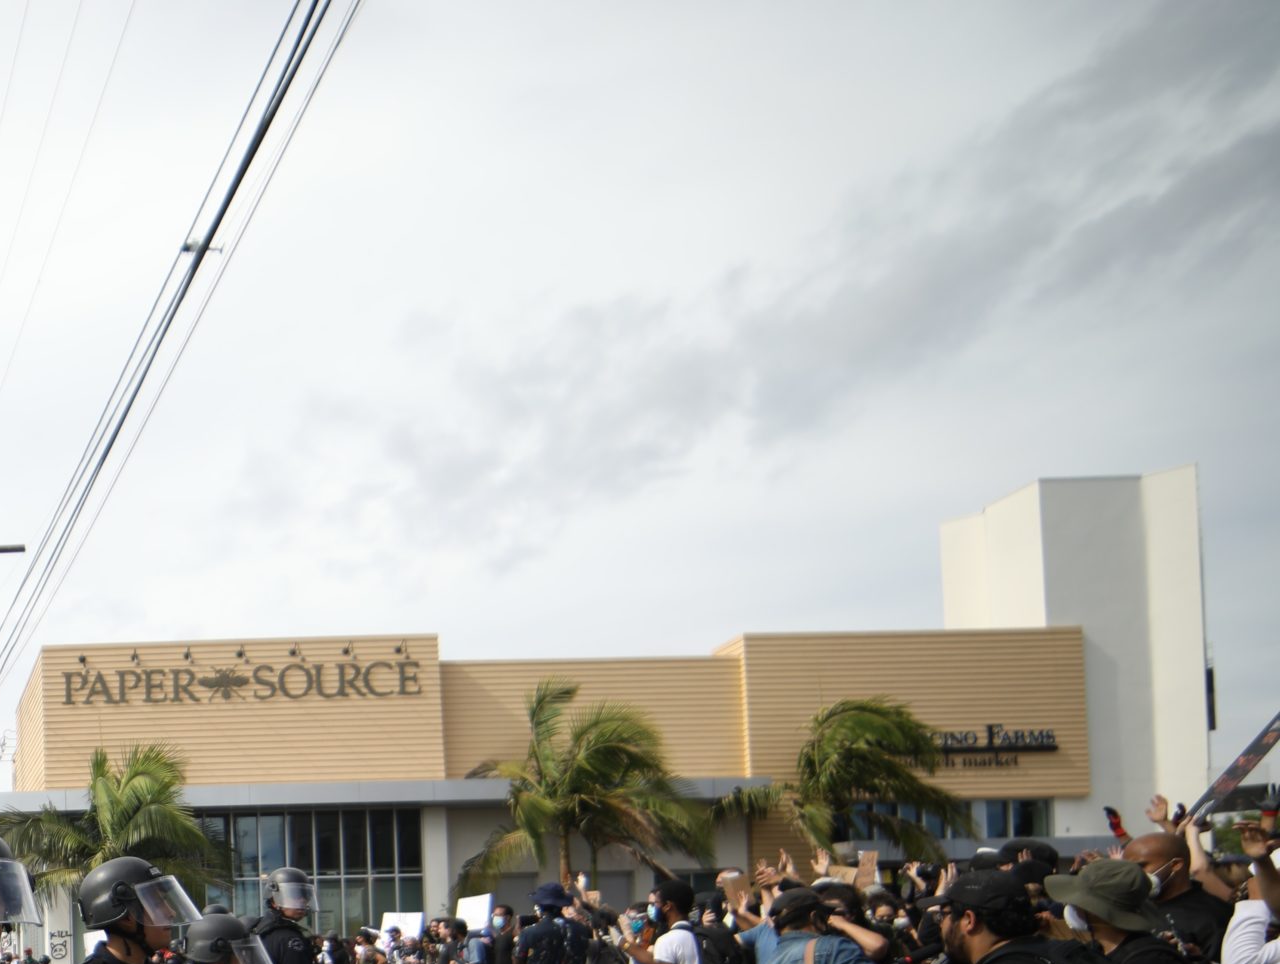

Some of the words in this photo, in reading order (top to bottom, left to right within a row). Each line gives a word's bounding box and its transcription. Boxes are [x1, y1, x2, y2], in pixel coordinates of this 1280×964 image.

[62, 668, 201, 705] PAPER
[253, 660, 422, 699] SOURCE
[961, 751, 1019, 768] market
[49, 930, 72, 940] KILL
